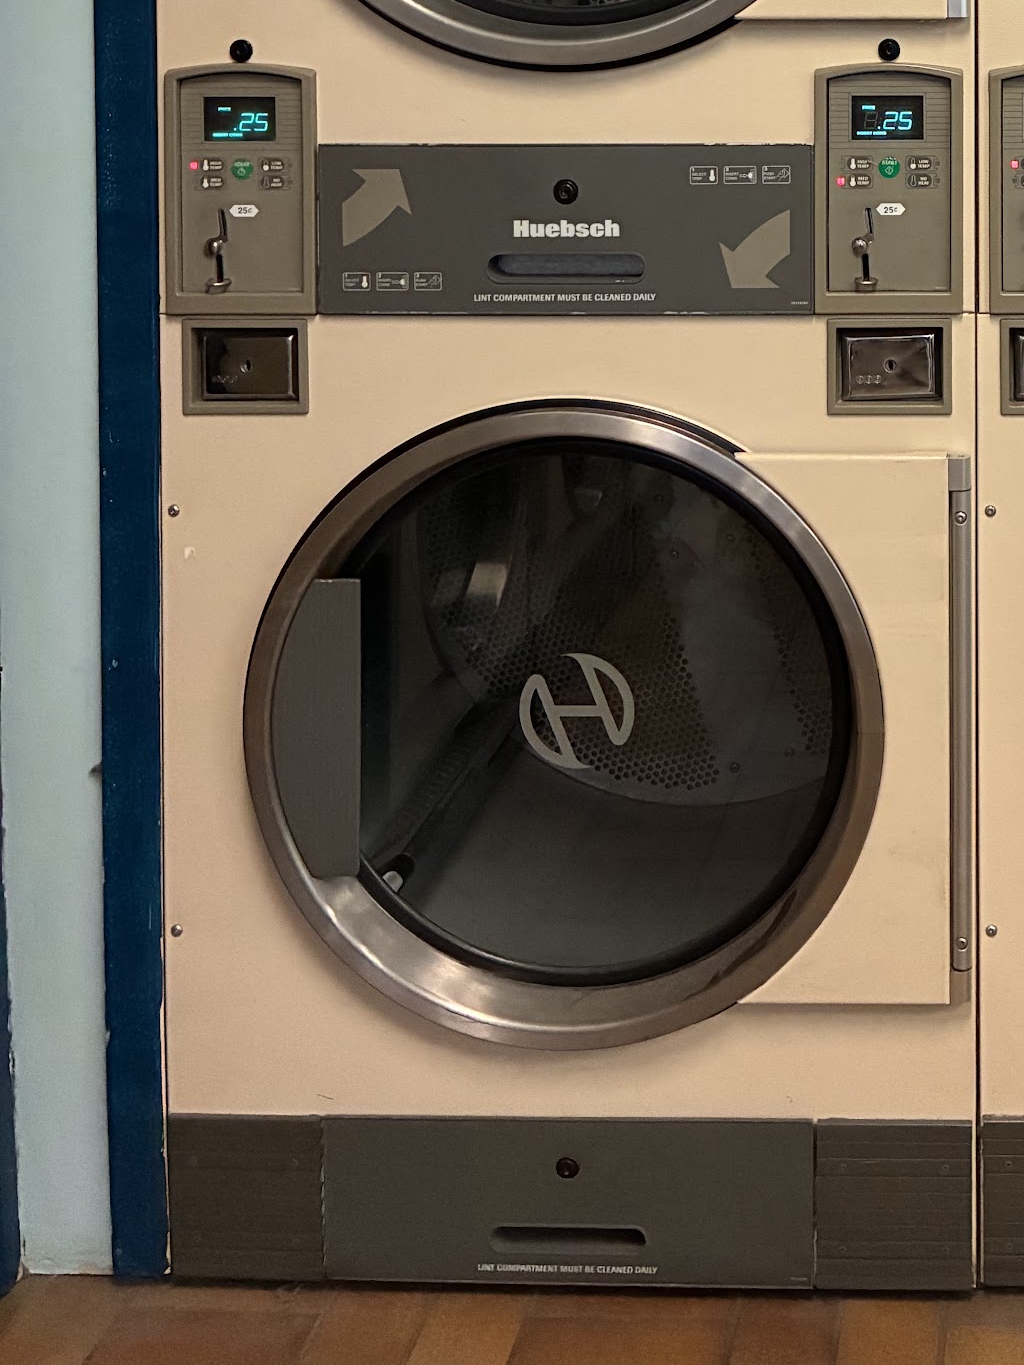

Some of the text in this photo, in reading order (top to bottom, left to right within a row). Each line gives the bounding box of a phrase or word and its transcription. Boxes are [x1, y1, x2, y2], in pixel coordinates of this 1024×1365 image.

[513, 220, 620, 238] Huebsch
[474, 294, 491, 302] LINT
[493, 294, 555, 302] COMPARTMENT
[633, 293, 656, 301] DAILY
[496, 1264, 558, 1272] COMPARTMENT
[560, 1265, 582, 1273] MUST
[597, 1266, 633, 1274] CLEANED
[635, 1266, 657, 1274] DAILY
